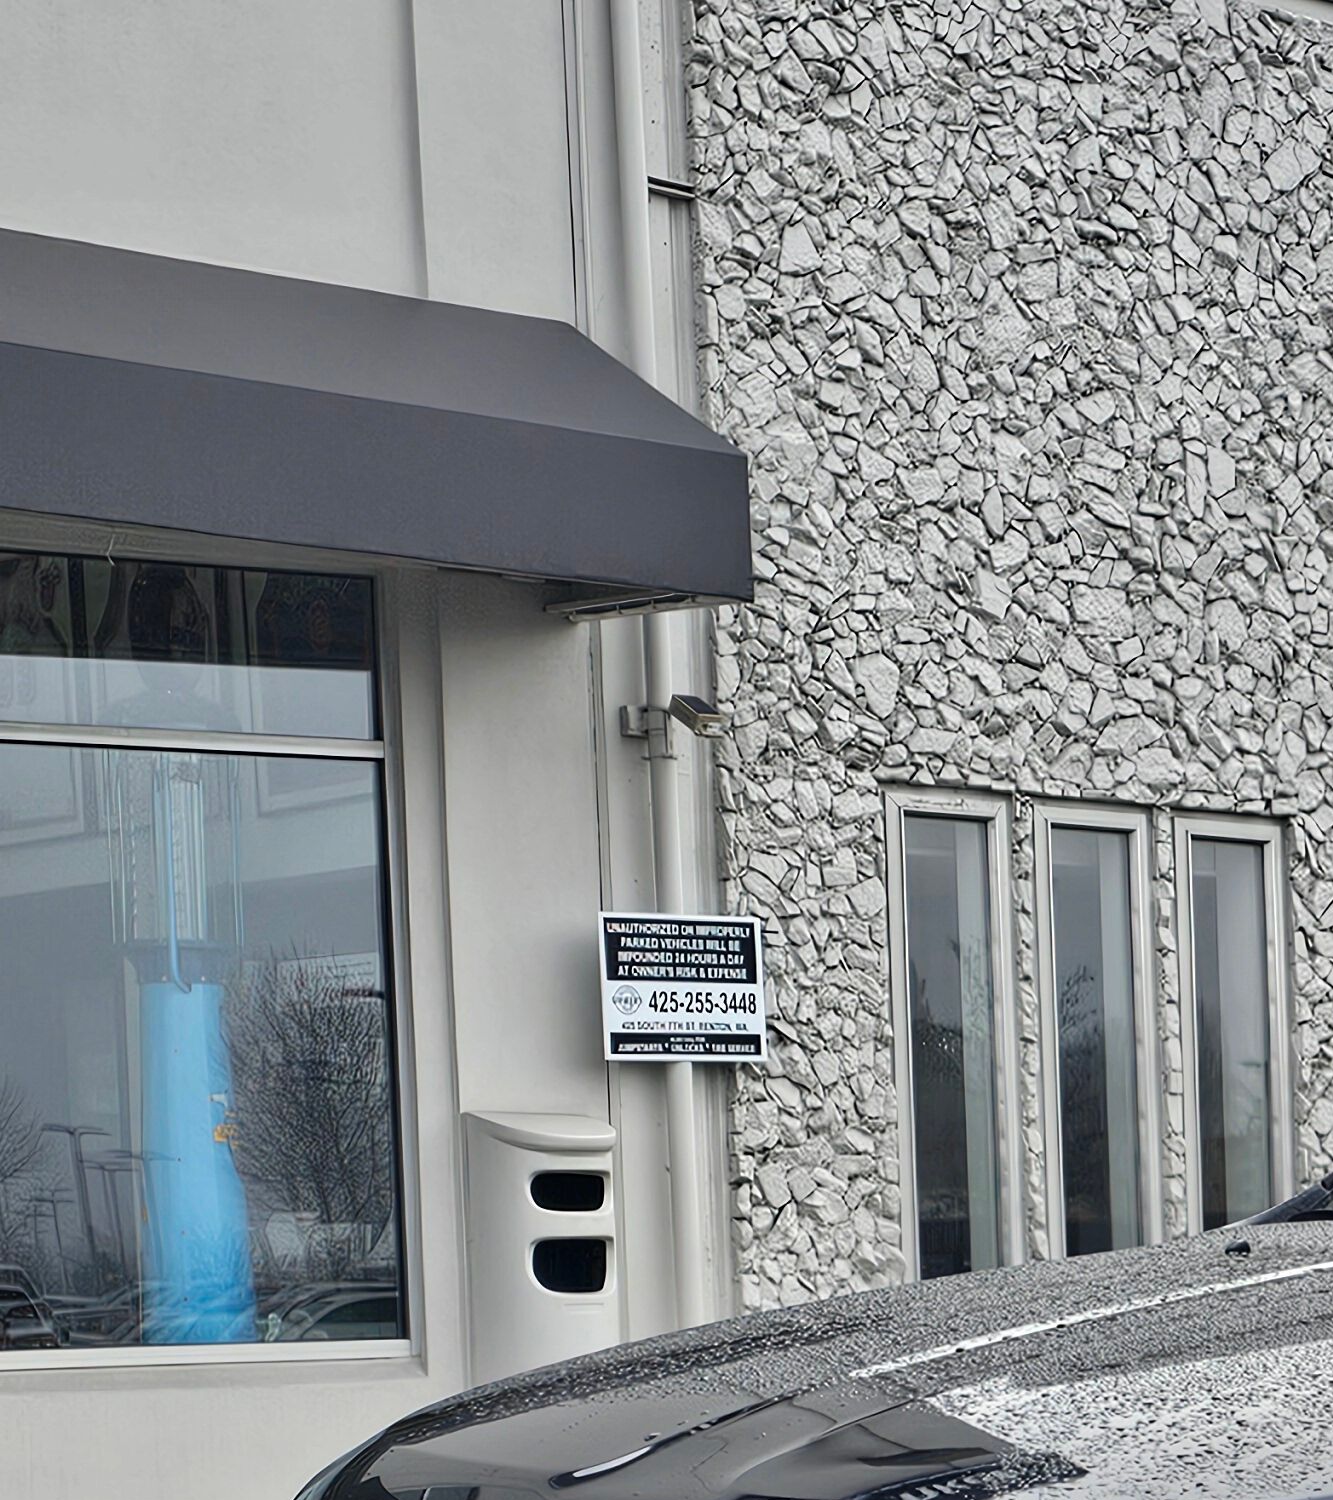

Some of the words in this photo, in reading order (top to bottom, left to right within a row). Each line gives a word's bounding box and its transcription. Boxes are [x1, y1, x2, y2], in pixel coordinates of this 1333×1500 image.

[620, 937, 659, 949] PARKED
[660, 938, 704, 951] VEHICLES
[617, 951, 673, 963] IMPOUNDED
[617, 966, 630, 976] AT
[648, 990, 757, 1014] 425-255-3448
